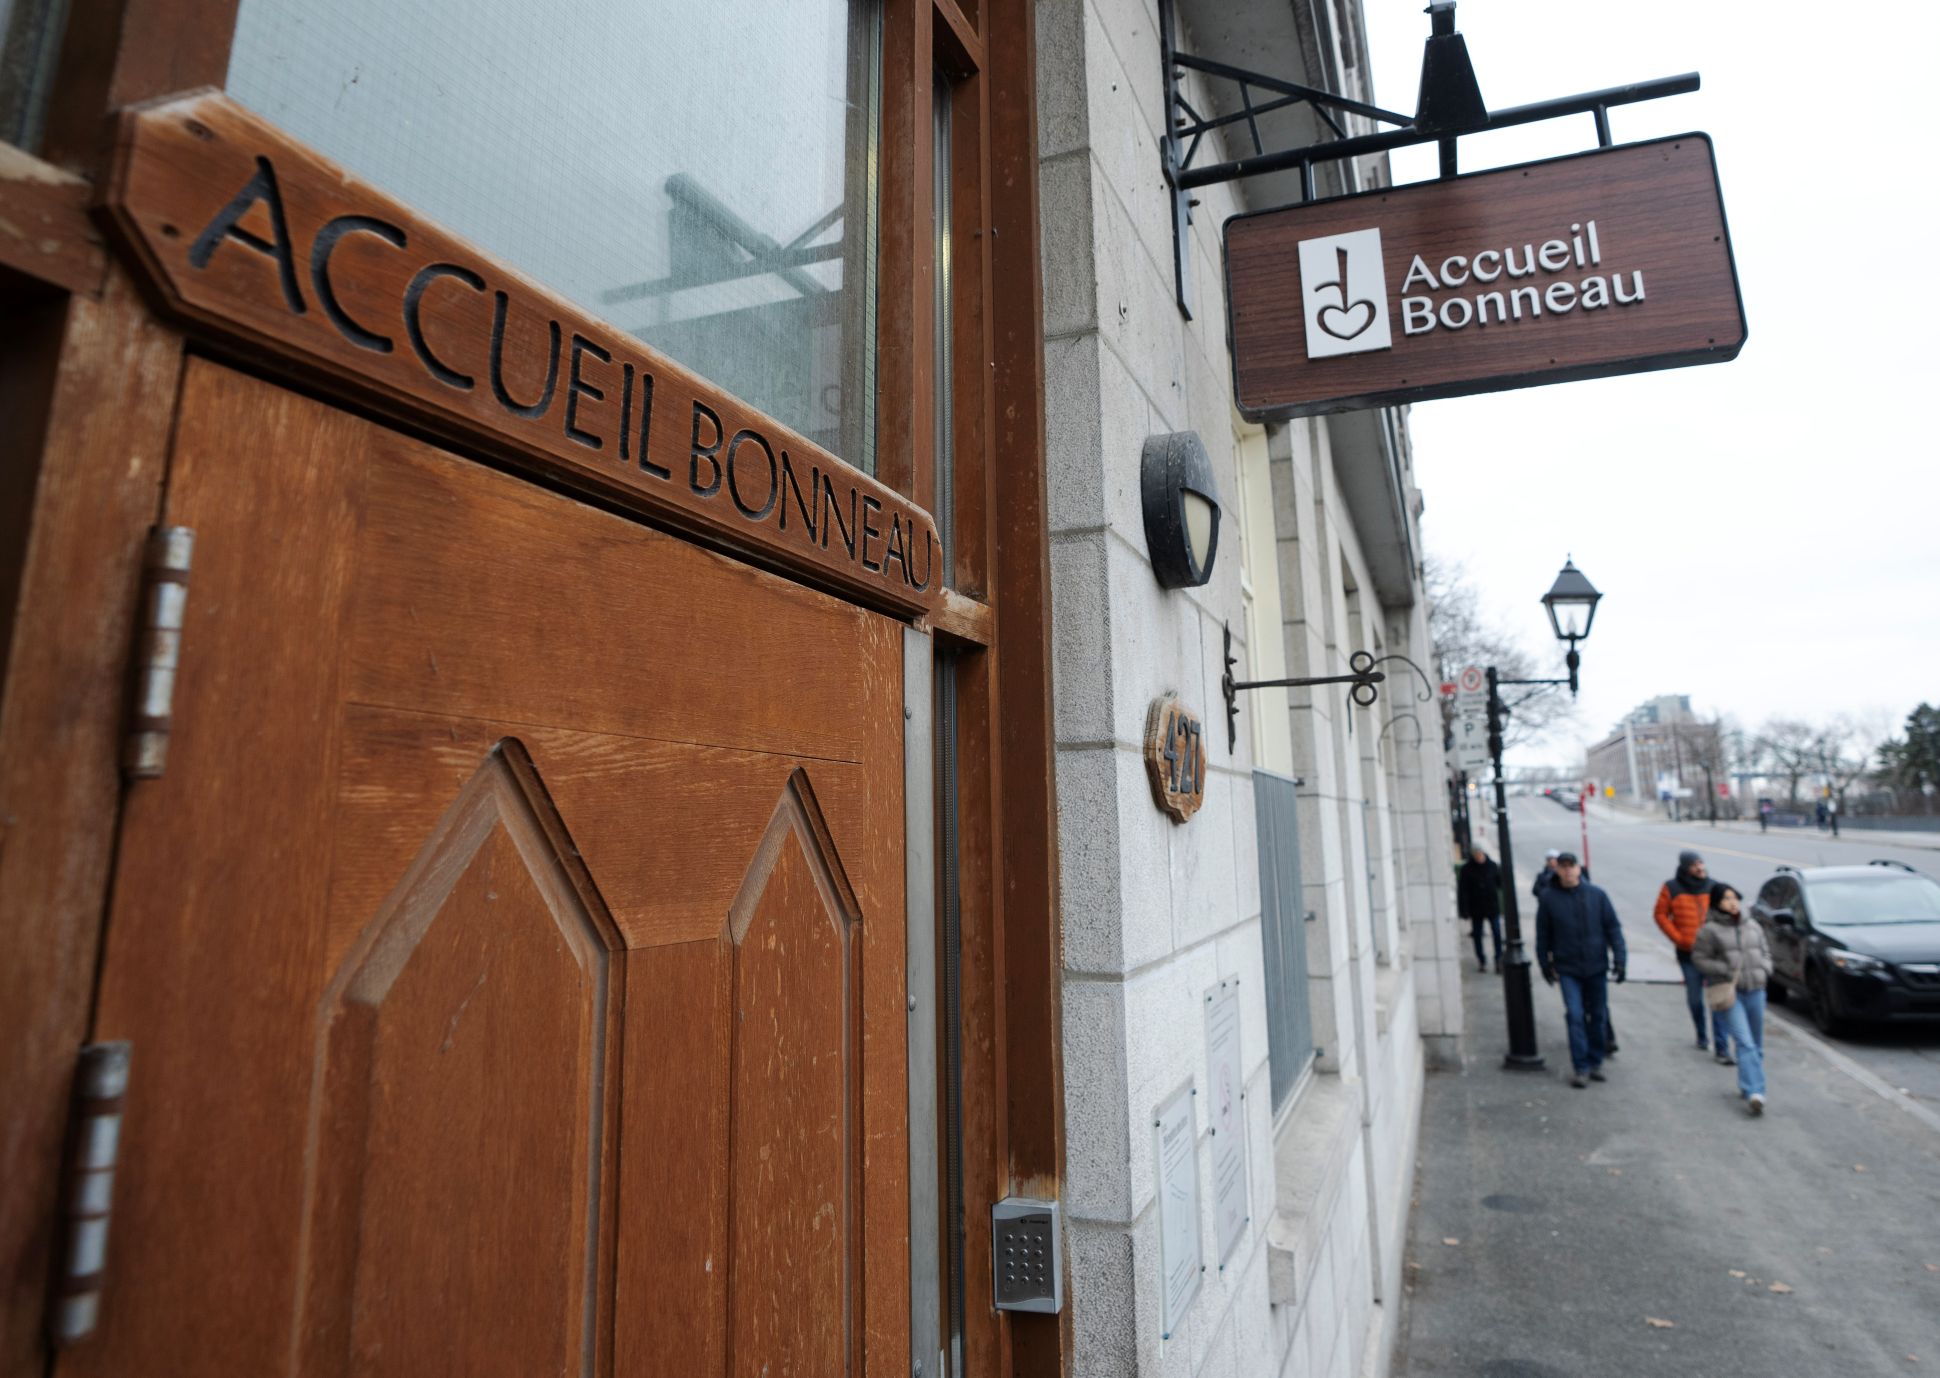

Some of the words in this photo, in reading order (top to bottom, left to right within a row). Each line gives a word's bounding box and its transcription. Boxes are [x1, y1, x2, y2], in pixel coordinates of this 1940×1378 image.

[1402, 220, 1602, 295] Accueil
[1402, 270, 1646, 336] Bonneau
[189, 155, 671, 481] ACCUEIL
[689, 399, 931, 593] BONNEAU
[1164, 710, 1201, 795] 427
